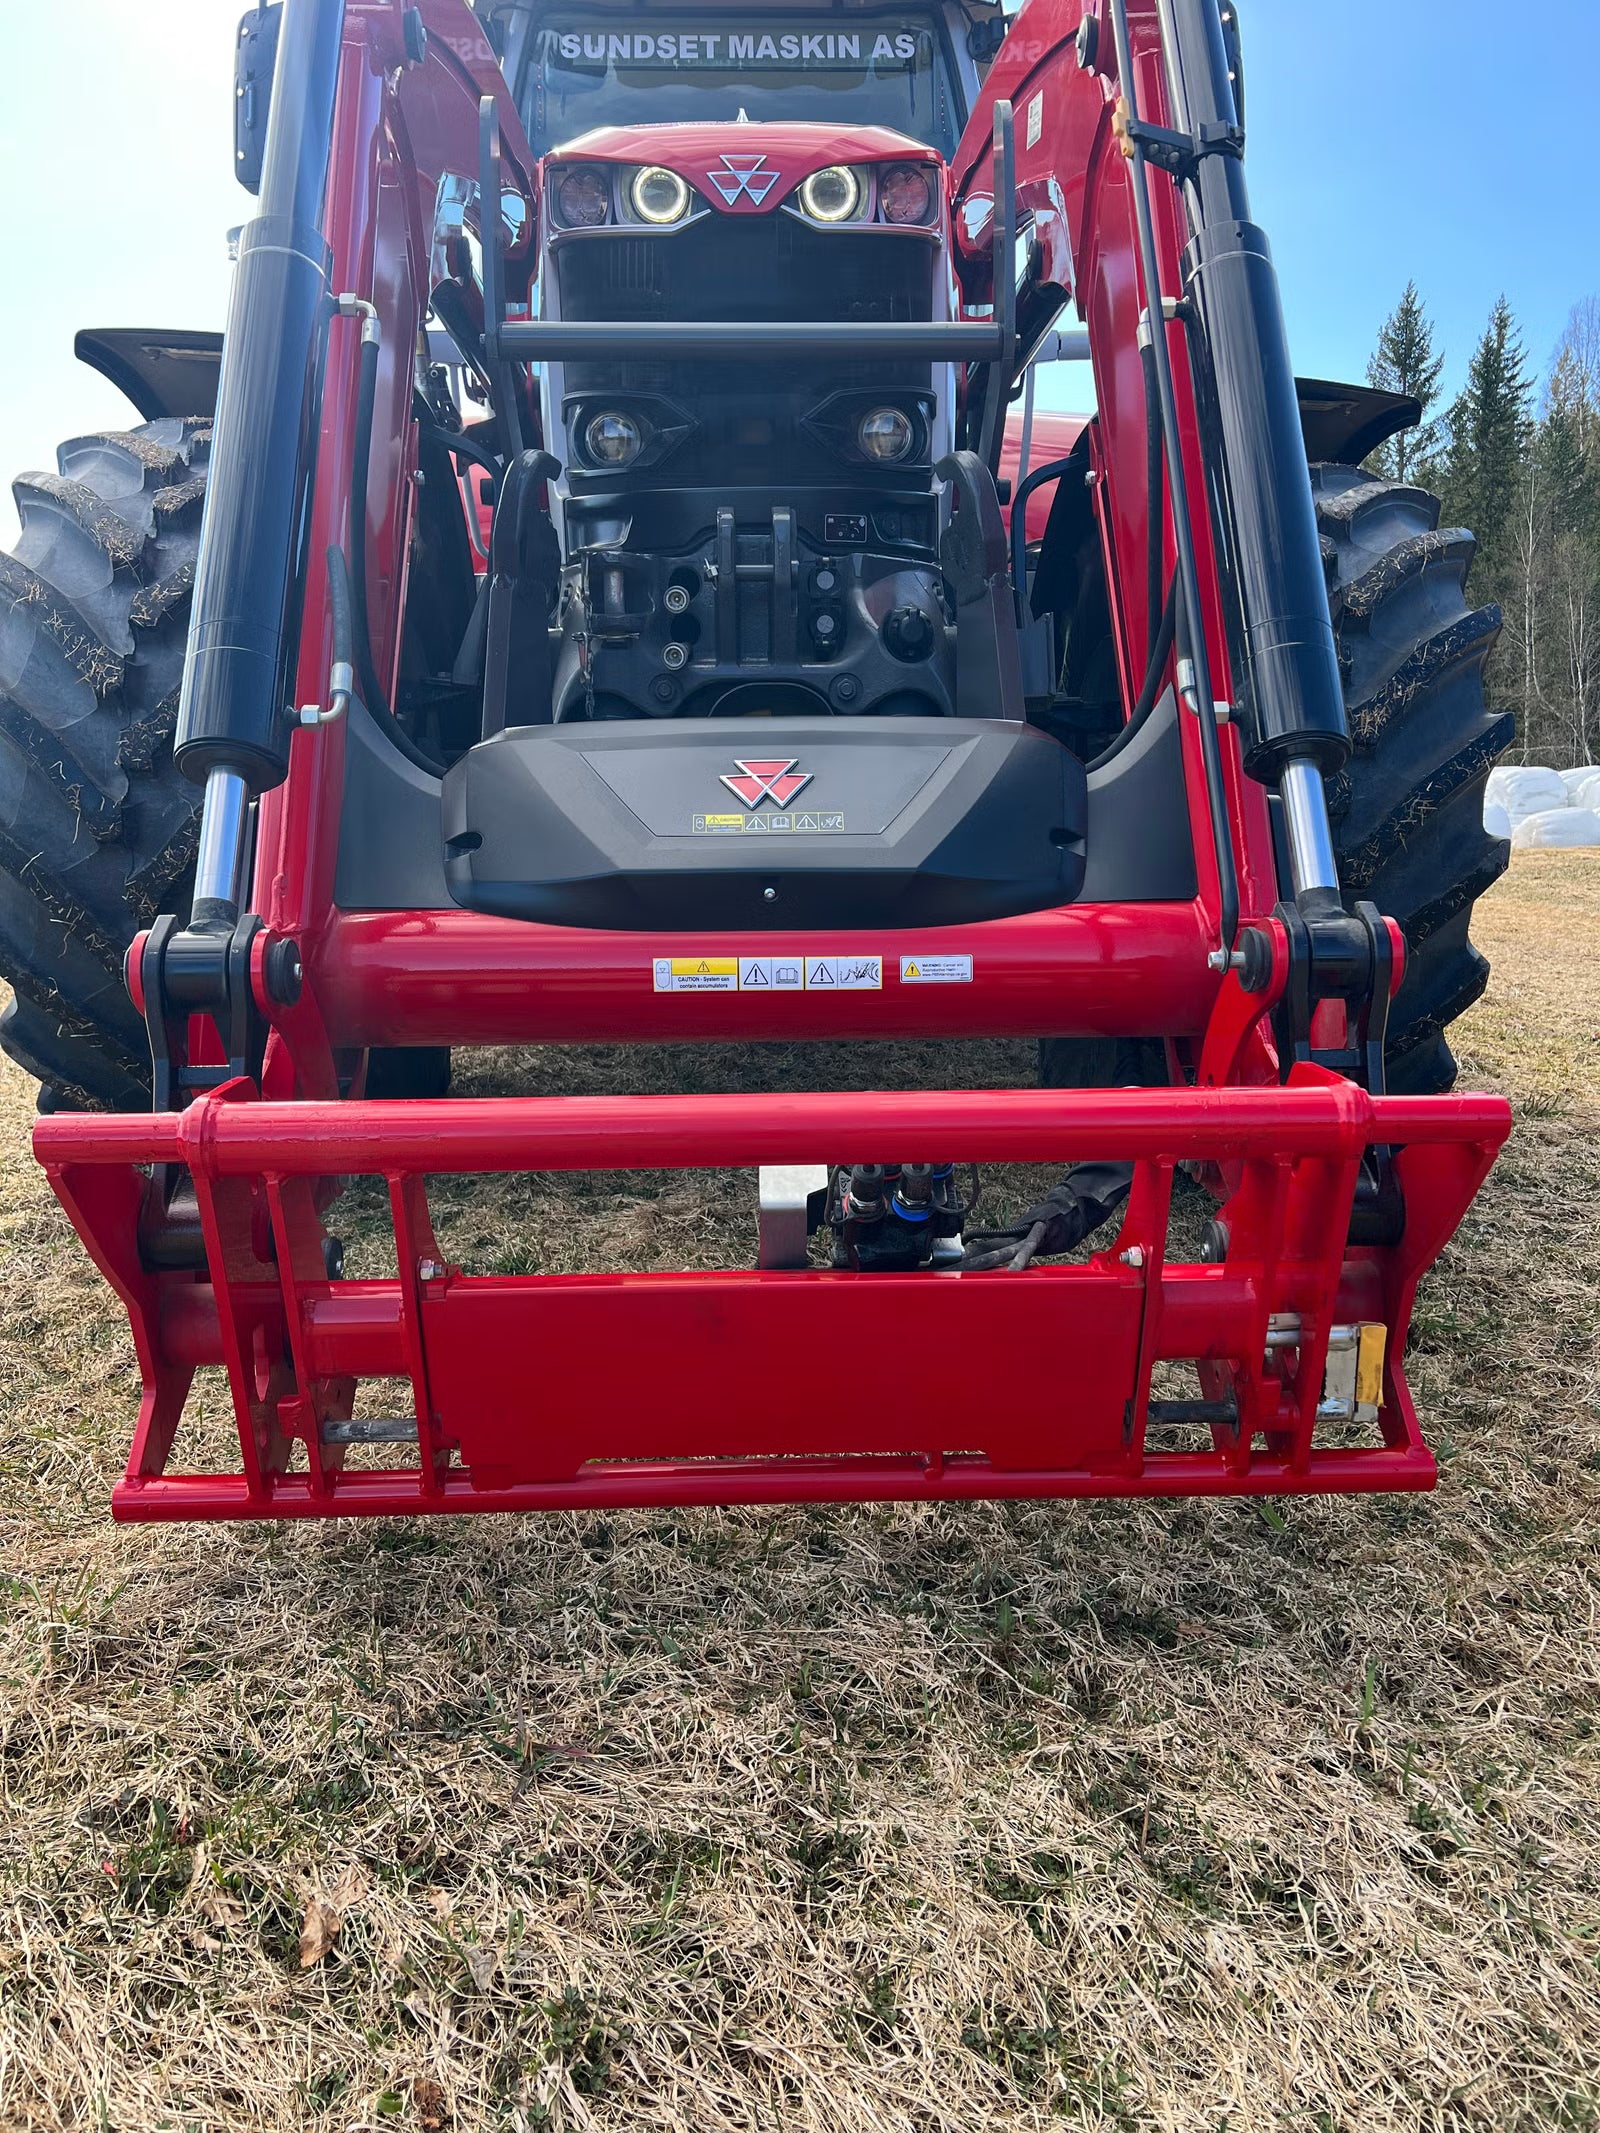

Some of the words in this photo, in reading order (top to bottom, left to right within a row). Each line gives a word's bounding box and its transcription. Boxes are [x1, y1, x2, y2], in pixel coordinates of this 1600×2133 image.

[561, 34, 720, 59] SUNDSET
[728, 34, 860, 59] MASKIN
[872, 34, 915, 59] AS
